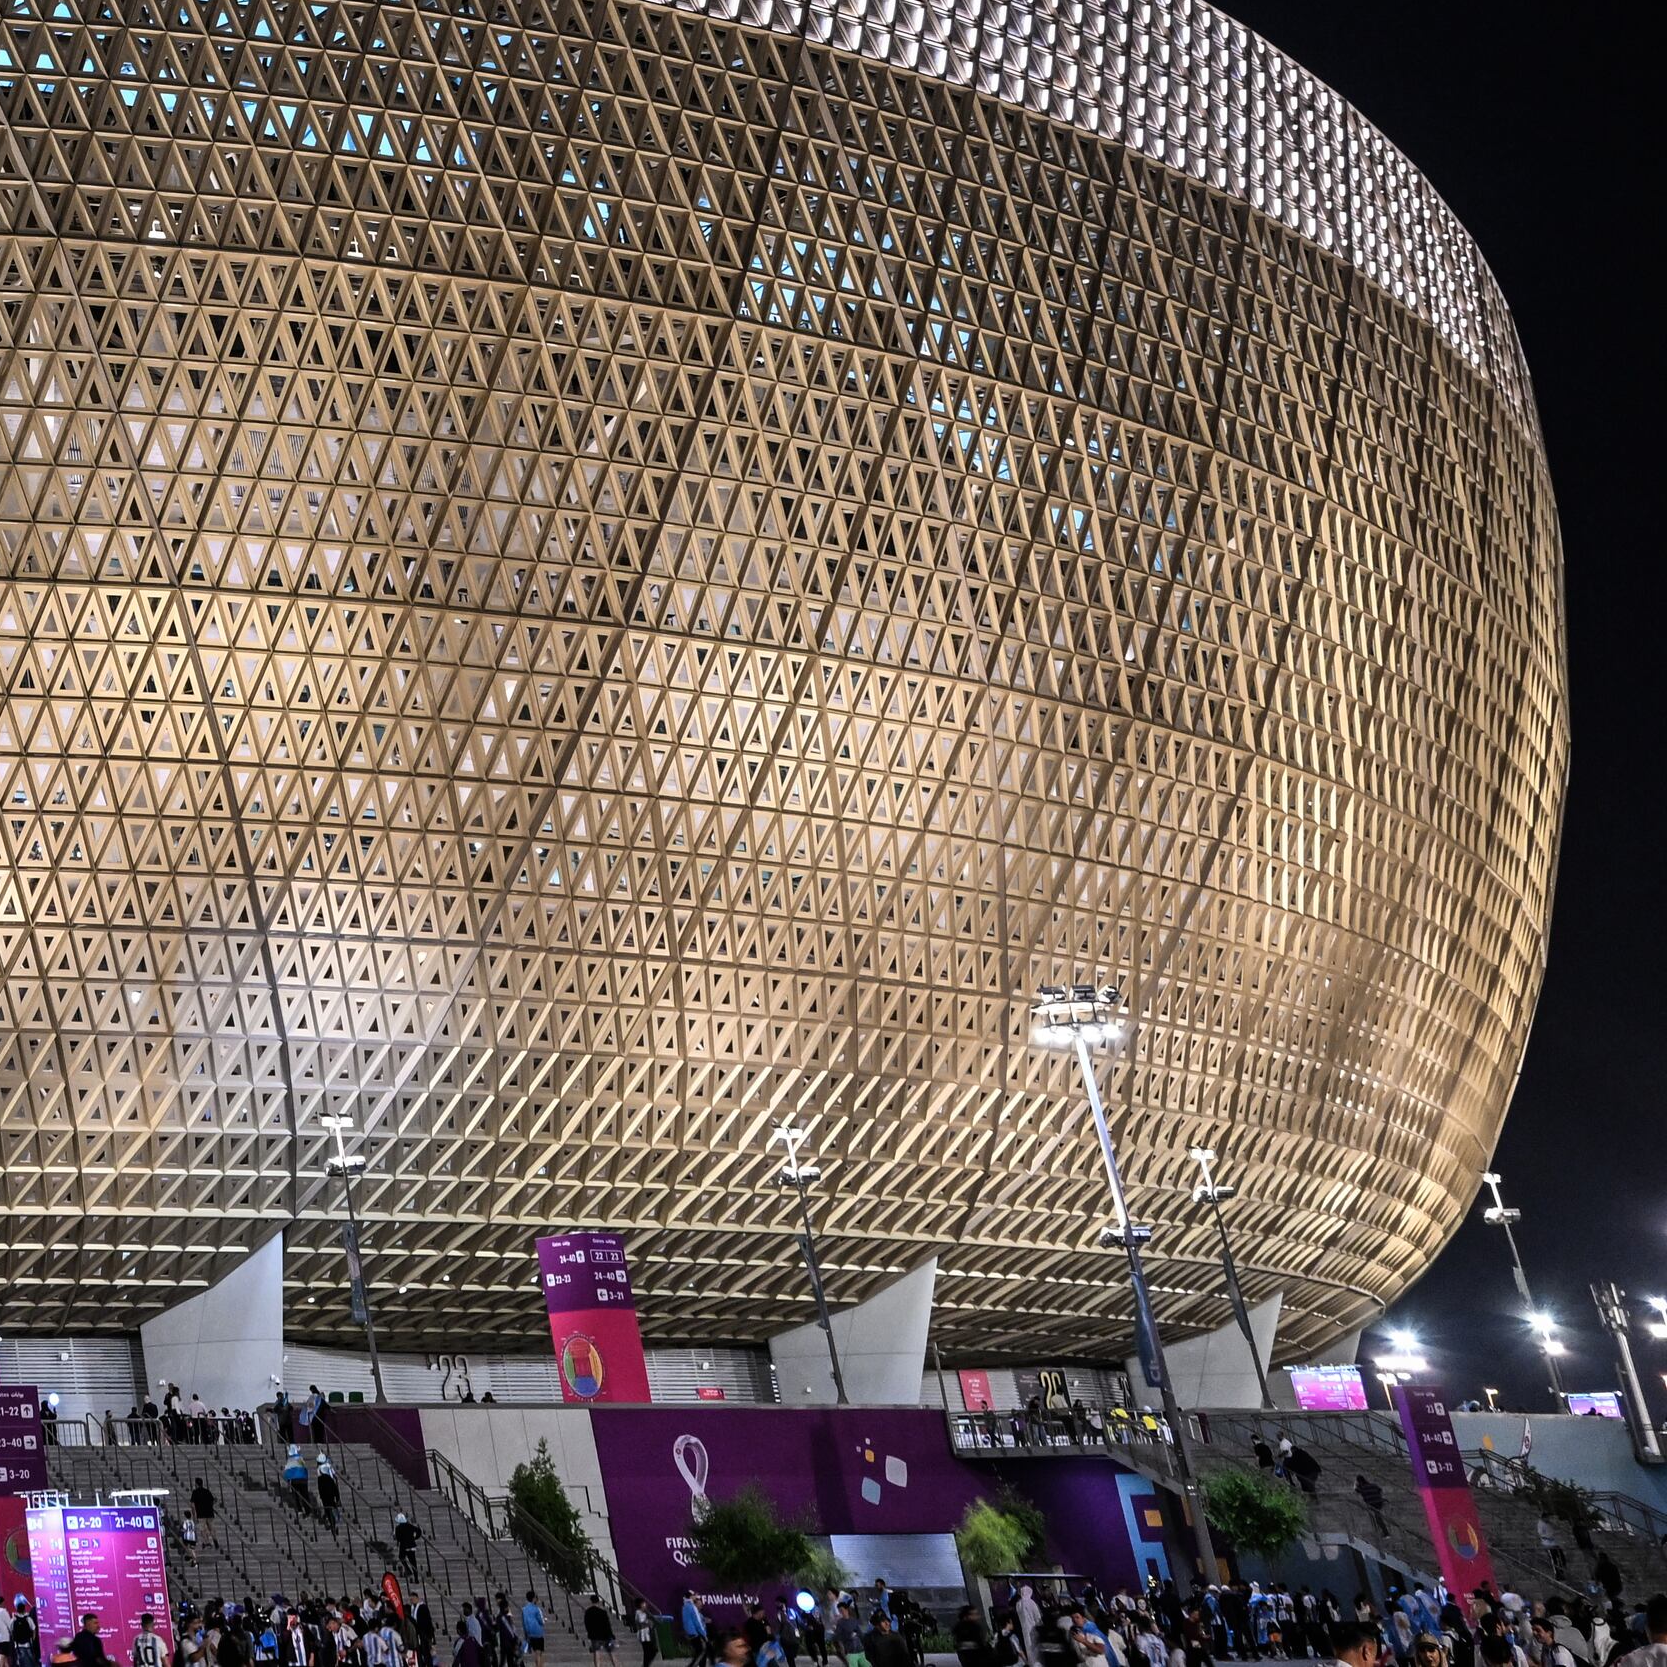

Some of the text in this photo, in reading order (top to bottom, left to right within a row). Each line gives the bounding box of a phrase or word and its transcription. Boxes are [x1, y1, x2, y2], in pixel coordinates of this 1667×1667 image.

[595, 1252, 603, 1260] 22
[610, 1253, 619, 1261] 23
[594, 1272, 615, 1280] 24-40
[609, 1291, 624, 1300] 3-21
[9, 1470, 30, 1479] 3-20
[79, 1516, 102, 1528] 2-20
[115, 1516, 142, 1528] 21-40
[666, 1537, 690, 1548] FIFA
